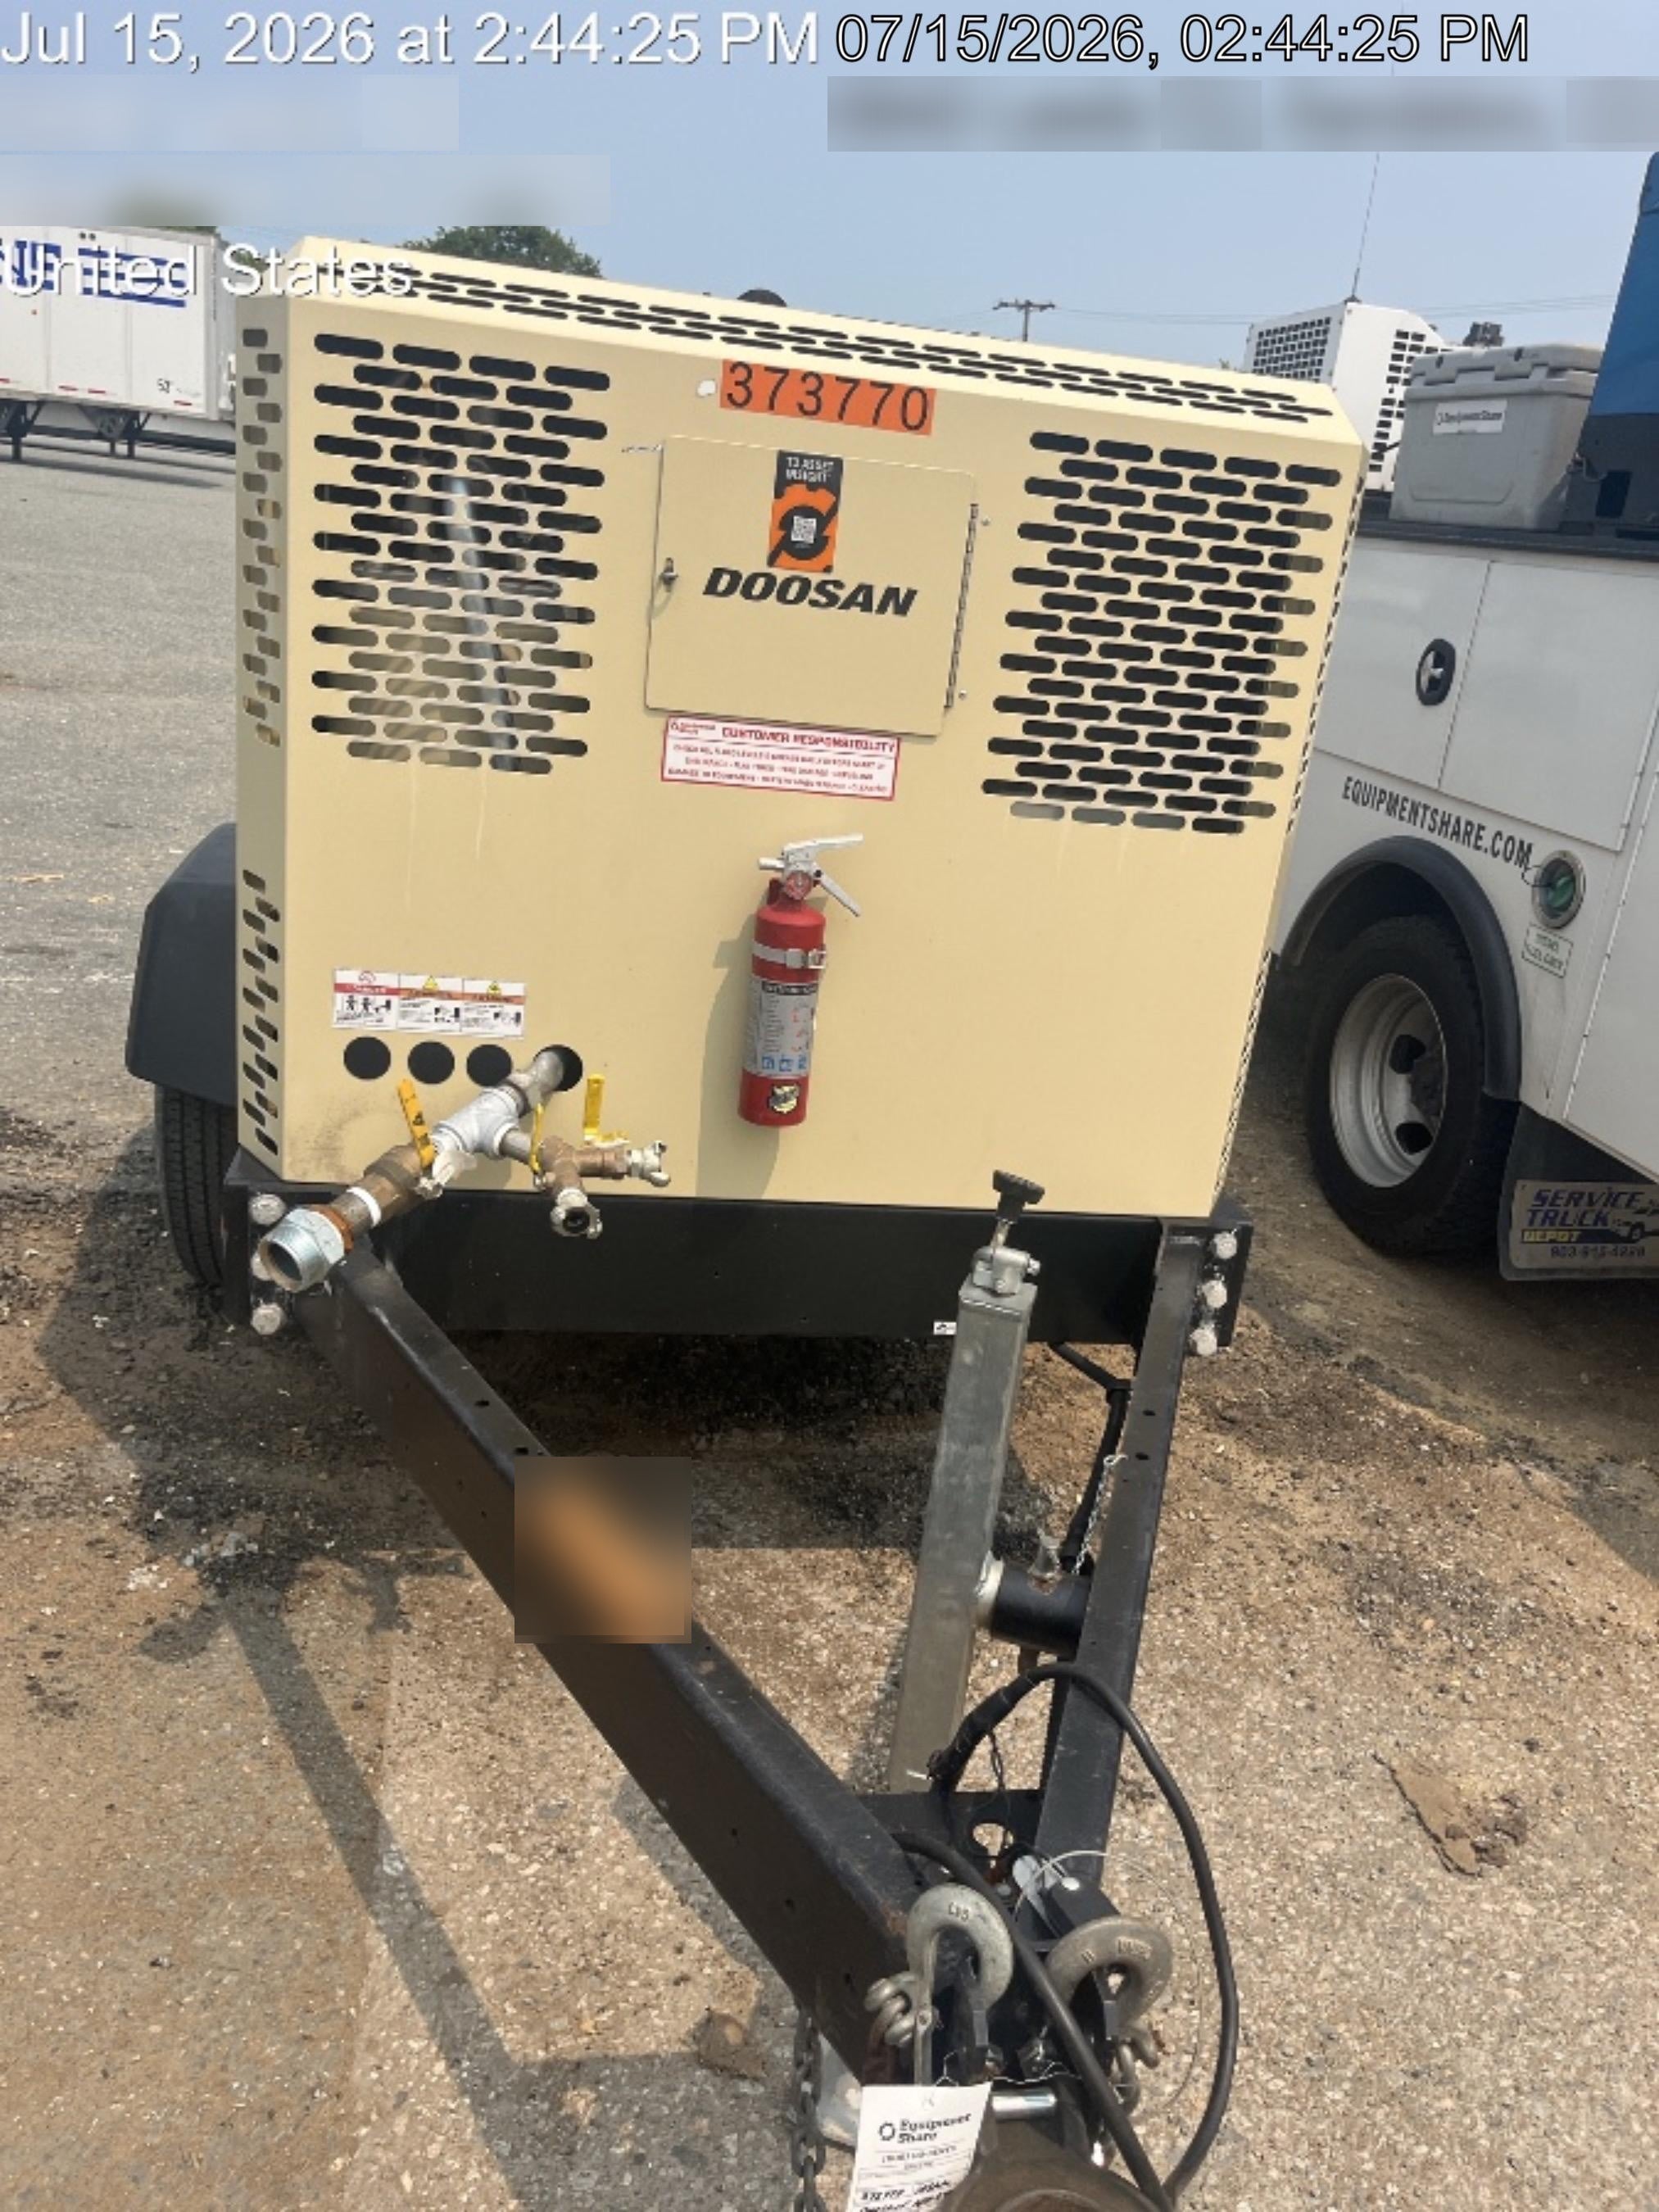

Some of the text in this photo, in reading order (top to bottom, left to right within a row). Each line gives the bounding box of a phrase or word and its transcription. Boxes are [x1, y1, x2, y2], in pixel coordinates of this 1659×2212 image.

[726, 360, 930, 432] 373770
[703, 567, 918, 617] DOOSAN
[722, 727, 790, 744] CUSTOMER
[793, 732, 895, 753] RESPONSIBILITY
[1342, 776, 1534, 868] EQUIPMENTSHARE.COM
[1531, 1187, 1646, 1208] SERVICE
[1526, 1208, 1611, 1227] TRUCK
